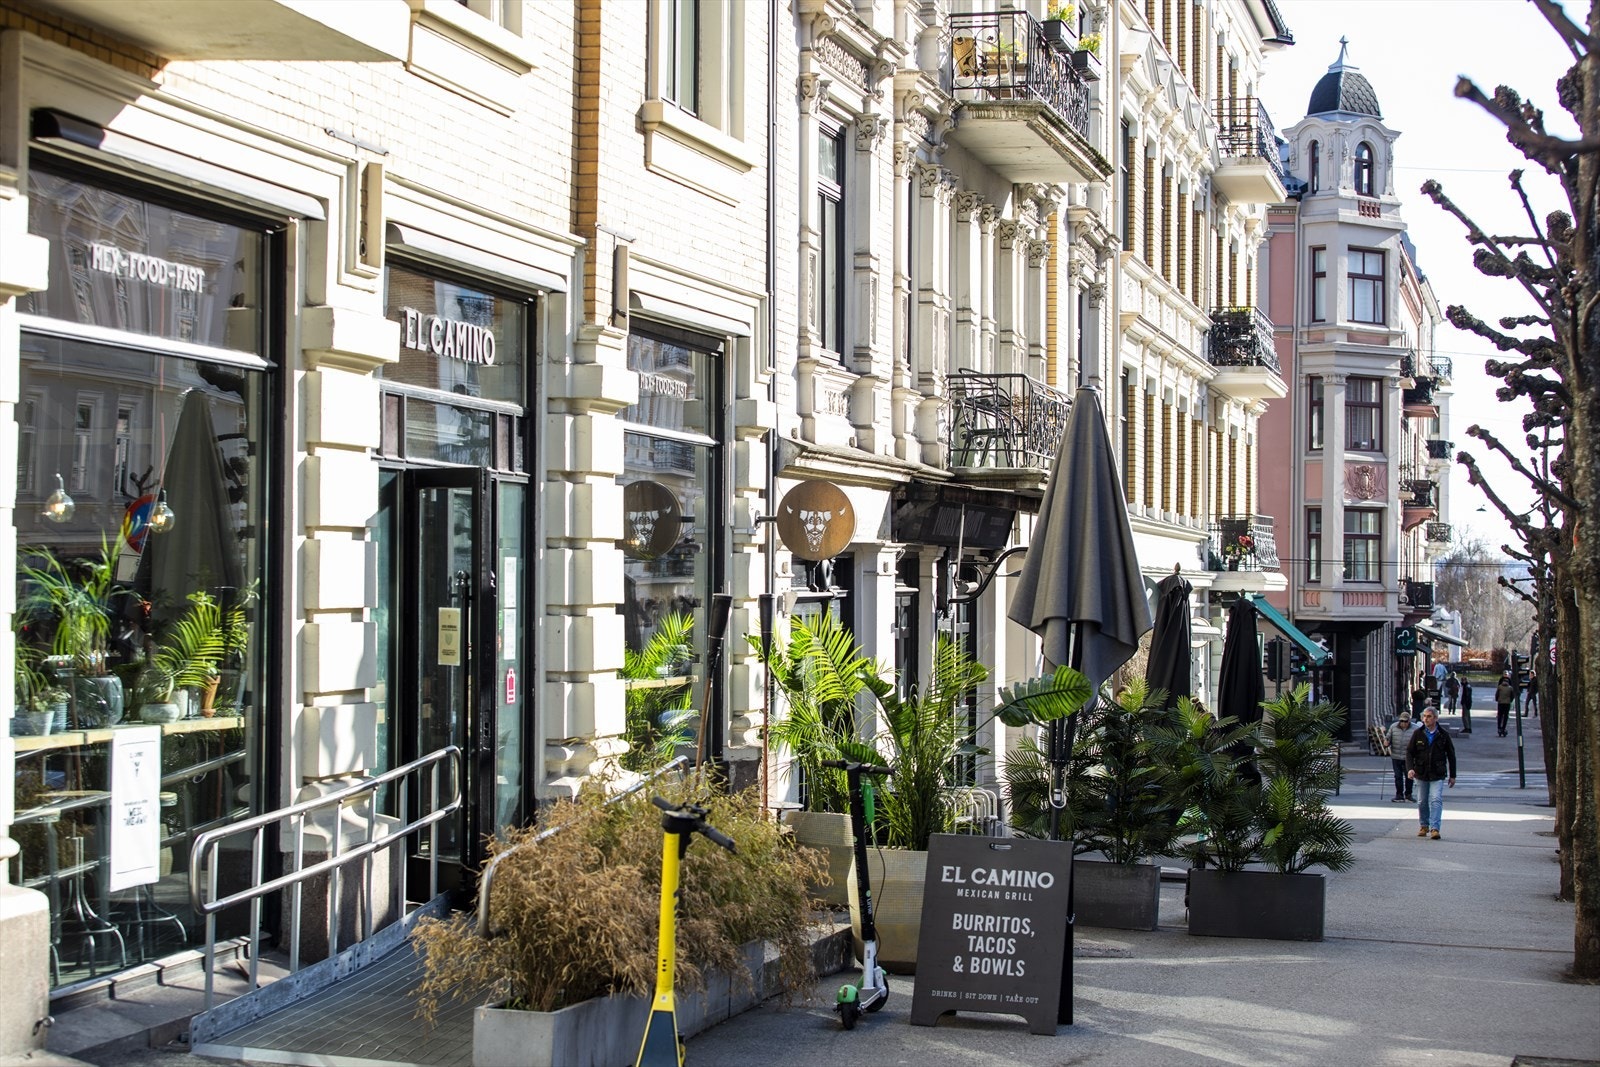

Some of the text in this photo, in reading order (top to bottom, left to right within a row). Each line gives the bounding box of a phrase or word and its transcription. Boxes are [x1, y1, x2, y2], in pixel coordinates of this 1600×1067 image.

[91, 243, 205, 293] MEX-FOOD-FAST
[404, 307, 496, 366] EL CAMINO
[941, 866, 1054, 888] EL CAMINO
[957, 888, 1033, 902] MEXICAN GRILL
[953, 913, 1035, 937] BURRITOS,
[968, 936, 1016, 954] TACOS
[952, 955, 1025, 977] & BOWLS
[931, 989, 1039, 1004] DRINKS SIT DOWN TAKE OUT
